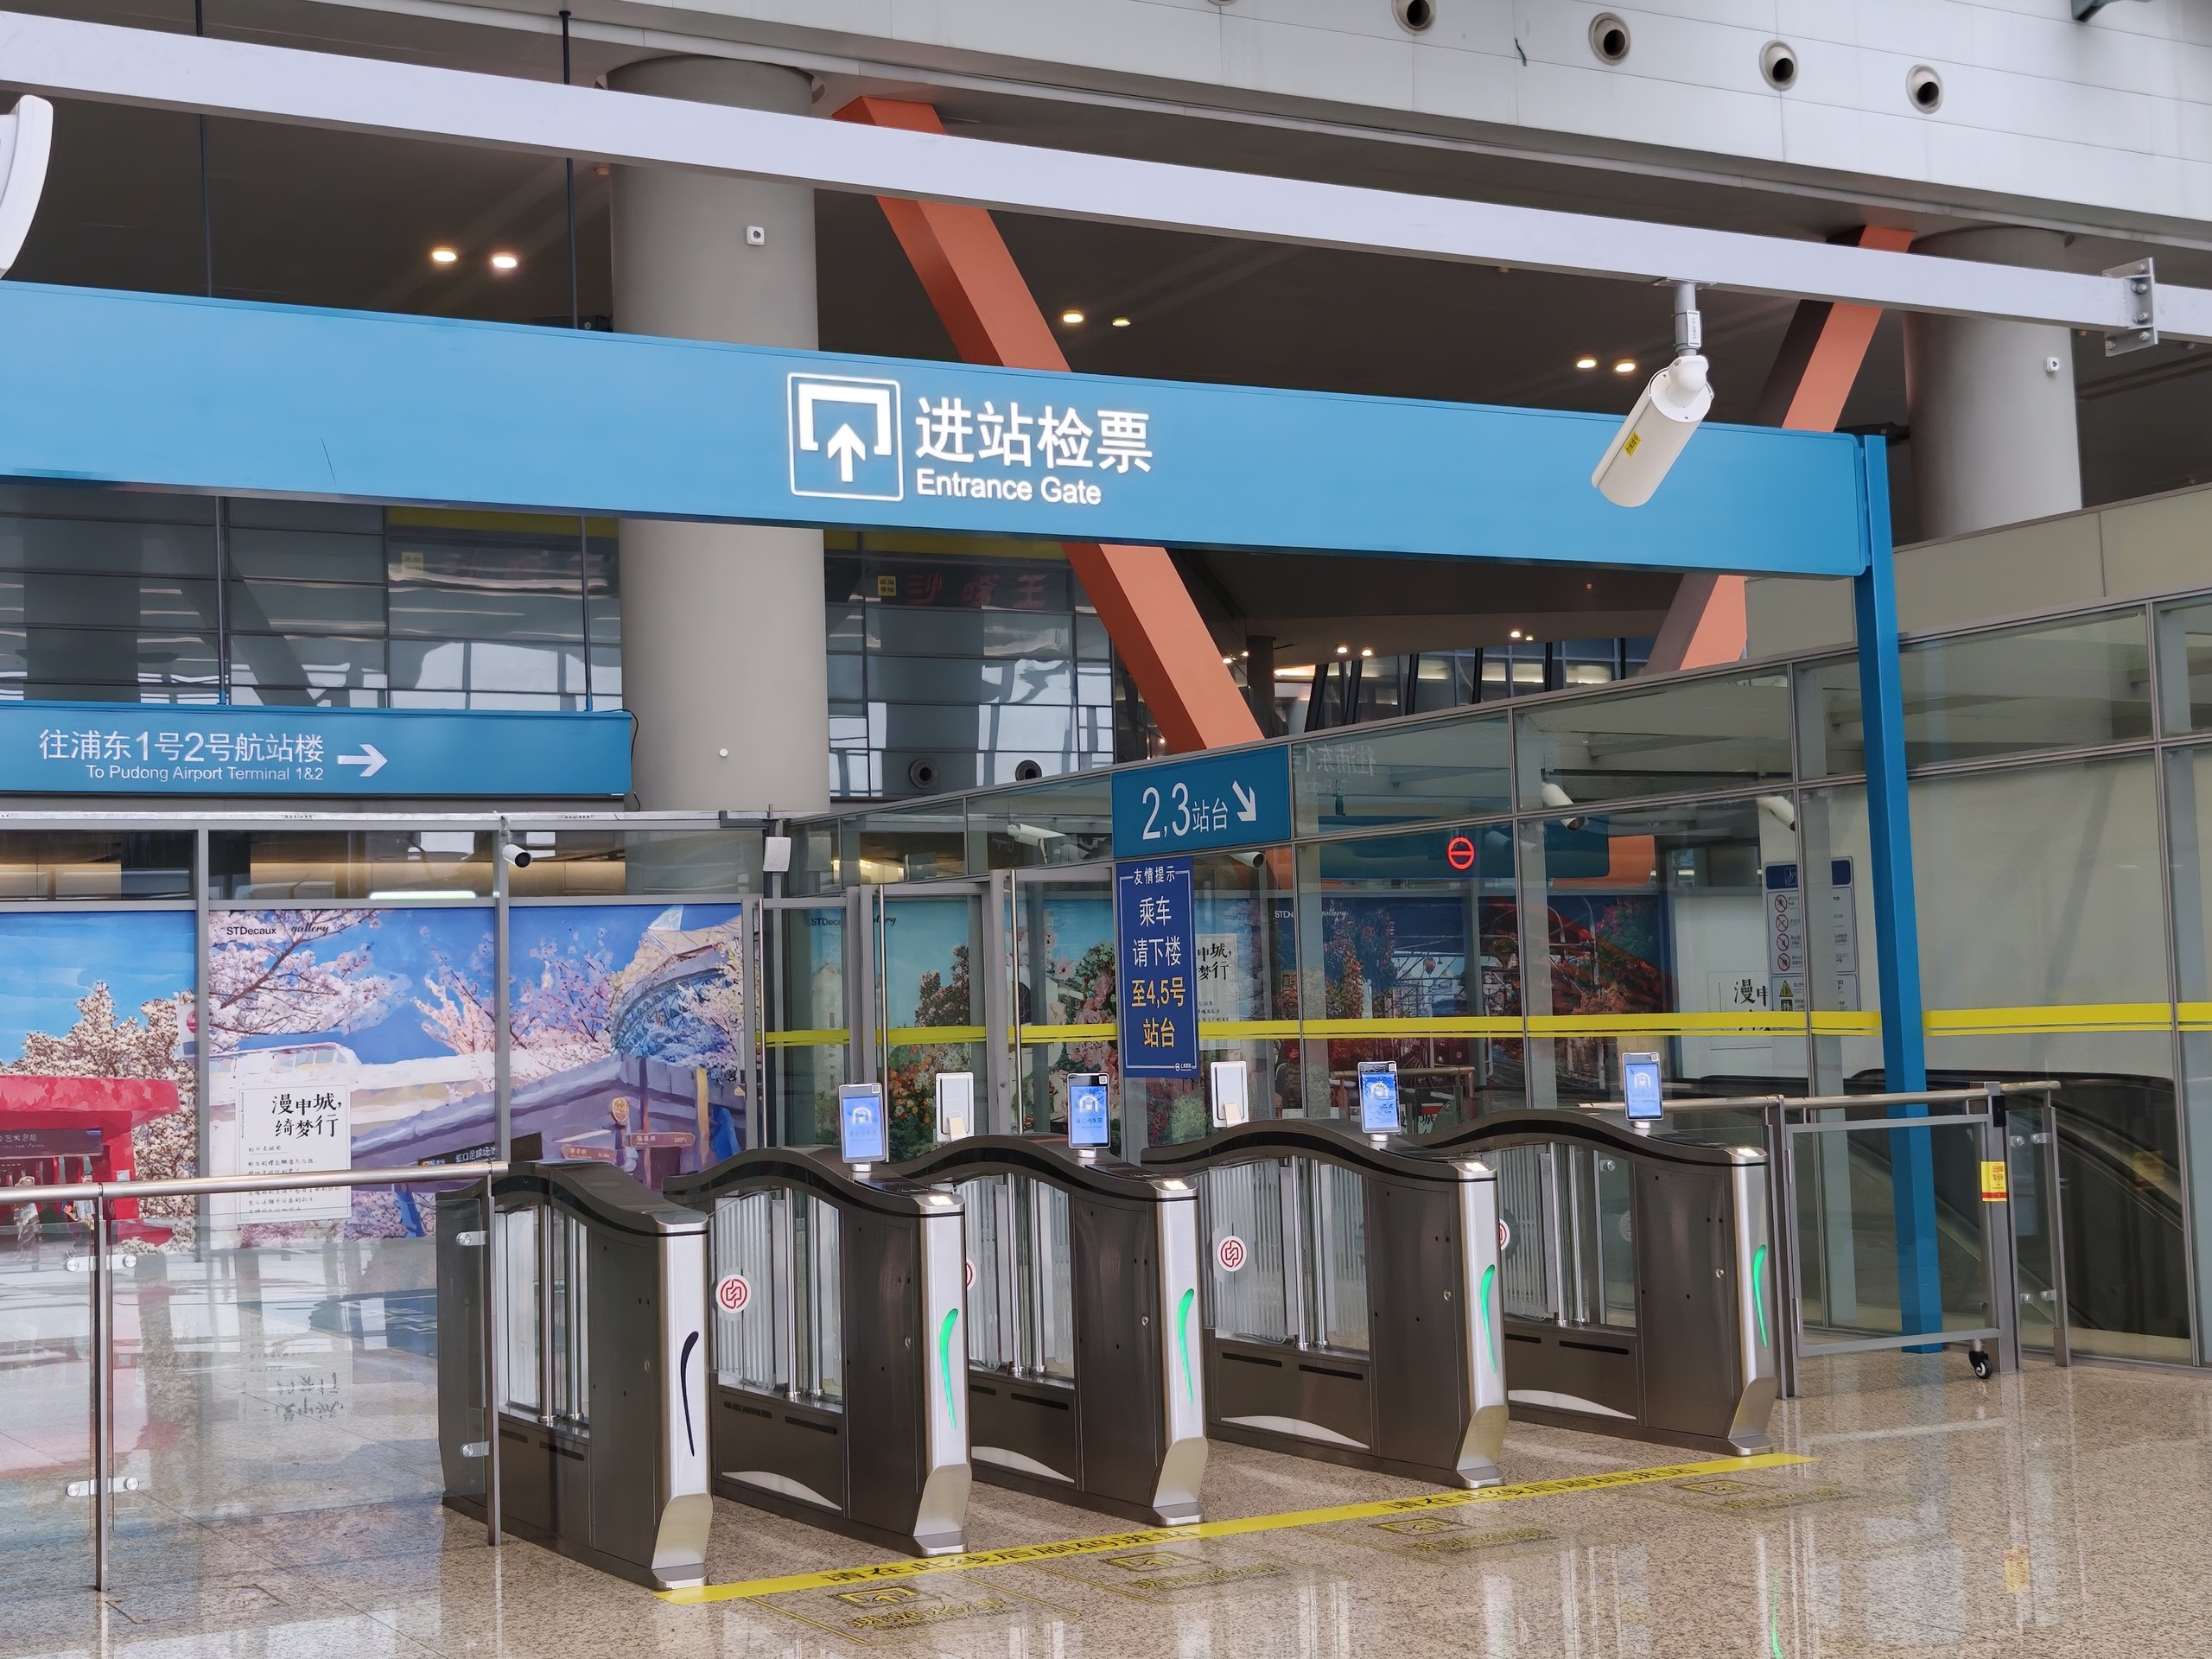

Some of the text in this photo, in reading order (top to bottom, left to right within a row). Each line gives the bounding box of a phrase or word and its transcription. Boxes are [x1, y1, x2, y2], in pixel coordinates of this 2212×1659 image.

[915, 397, 1153, 474] 进站检票
[917, 468, 1102, 505] Entrance Gate
[39, 728, 324, 763] 往浦东1号2号航站楼
[86, 765, 324, 783] To Pudong Airport Terminal 1&2
[1134, 865, 1175, 885] 友情提示
[1139, 895, 1172, 927] 乘车
[226, 926, 276, 936] STDecaux
[1133, 936, 1182, 968] 请下楼
[1131, 976, 1185, 1009] 至4,5号
[1143, 1017, 1175, 1048] 站台
[275, 1114, 339, 1139] 绮梦行
